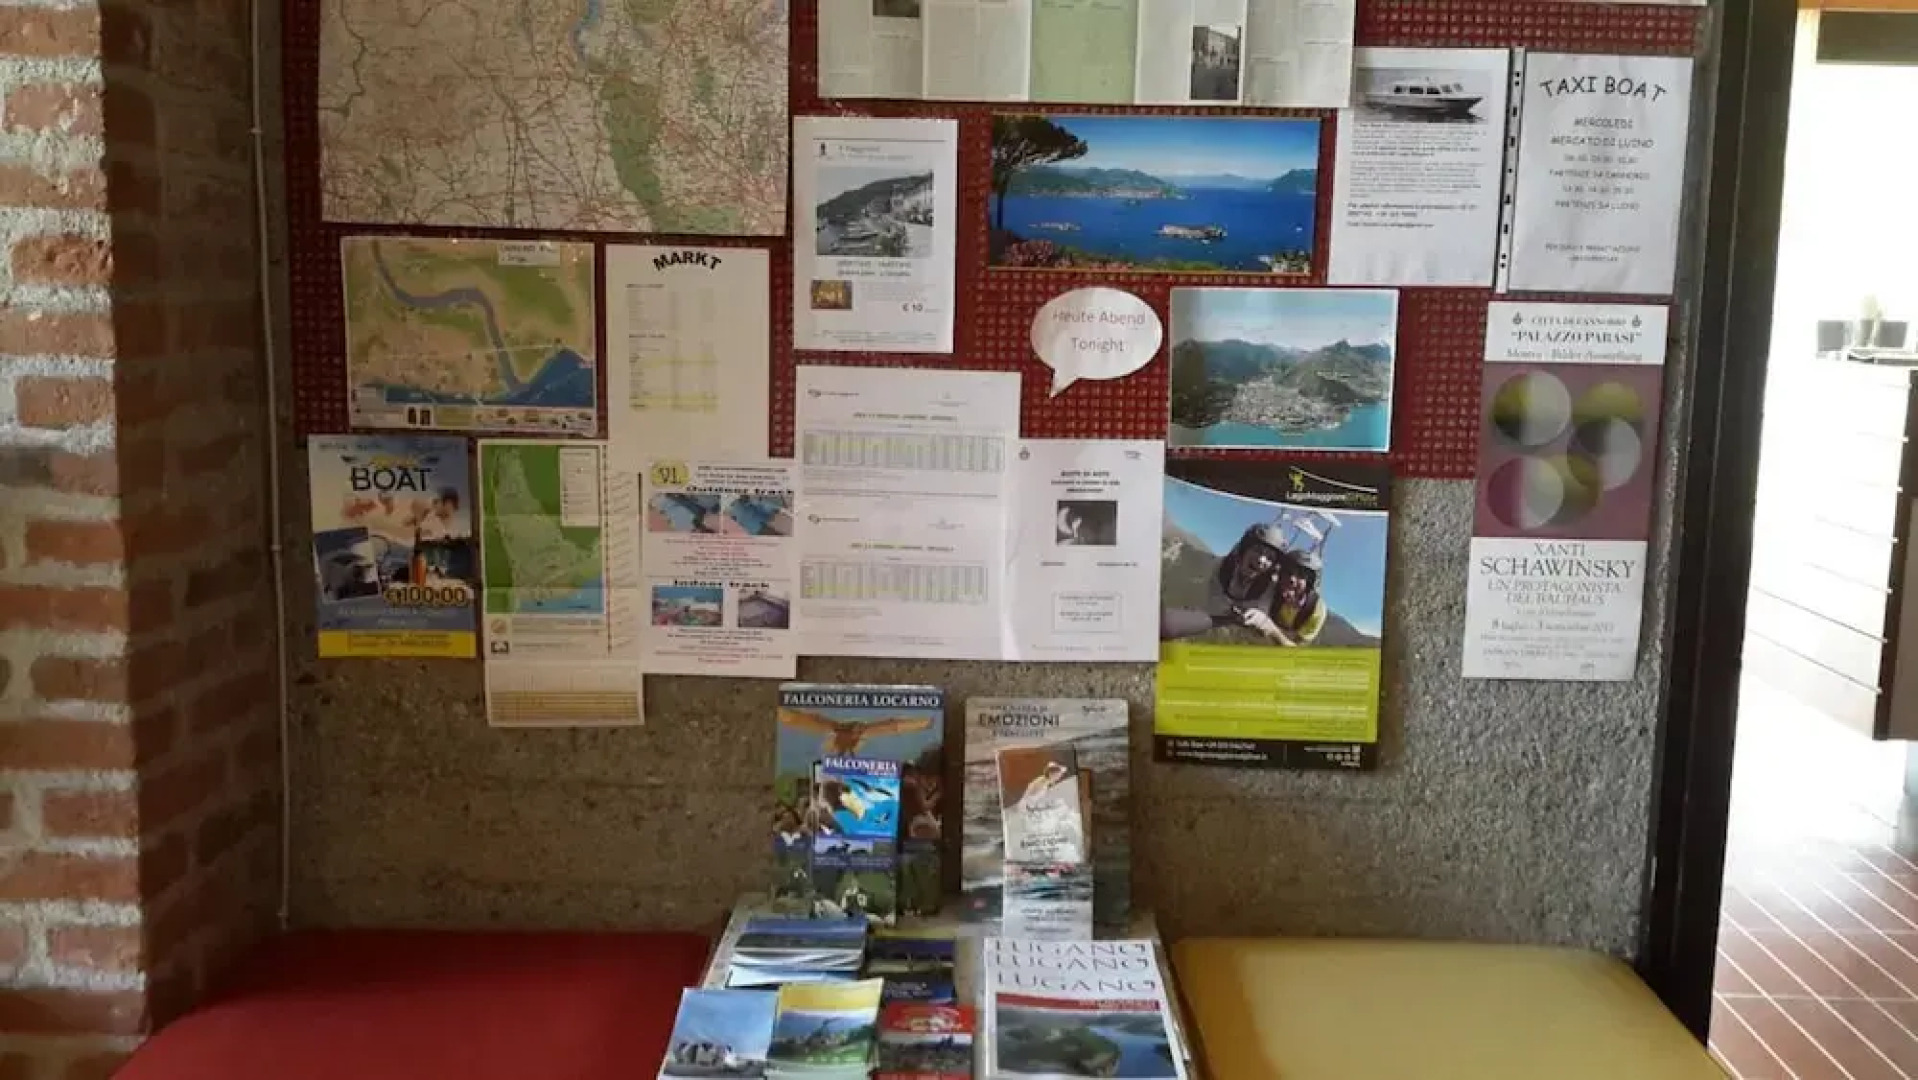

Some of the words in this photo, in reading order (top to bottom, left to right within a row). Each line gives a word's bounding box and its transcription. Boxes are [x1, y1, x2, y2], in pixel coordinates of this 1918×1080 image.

[1539, 76, 1598, 98] TAXI
[1604, 75, 1667, 102] BOAT
[652, 249, 723, 272] MARKT
[911, 302, 923, 312] 10
[1052, 309, 1094, 324] Heute
[1099, 310, 1146, 325] Abend
[1070, 337, 1124, 355] Tonight
[351, 467, 432, 491] BOAT
[1534, 543, 1585, 557] XANTI
[1480, 556, 1635, 578] SCHAWINSKY
[783, 692, 869, 706] FALCONERIA
[873, 694, 939, 708] LOCARNO
[978, 713, 1060, 727] EMOZIONI
[825, 757, 897, 771] FALCONERIA
